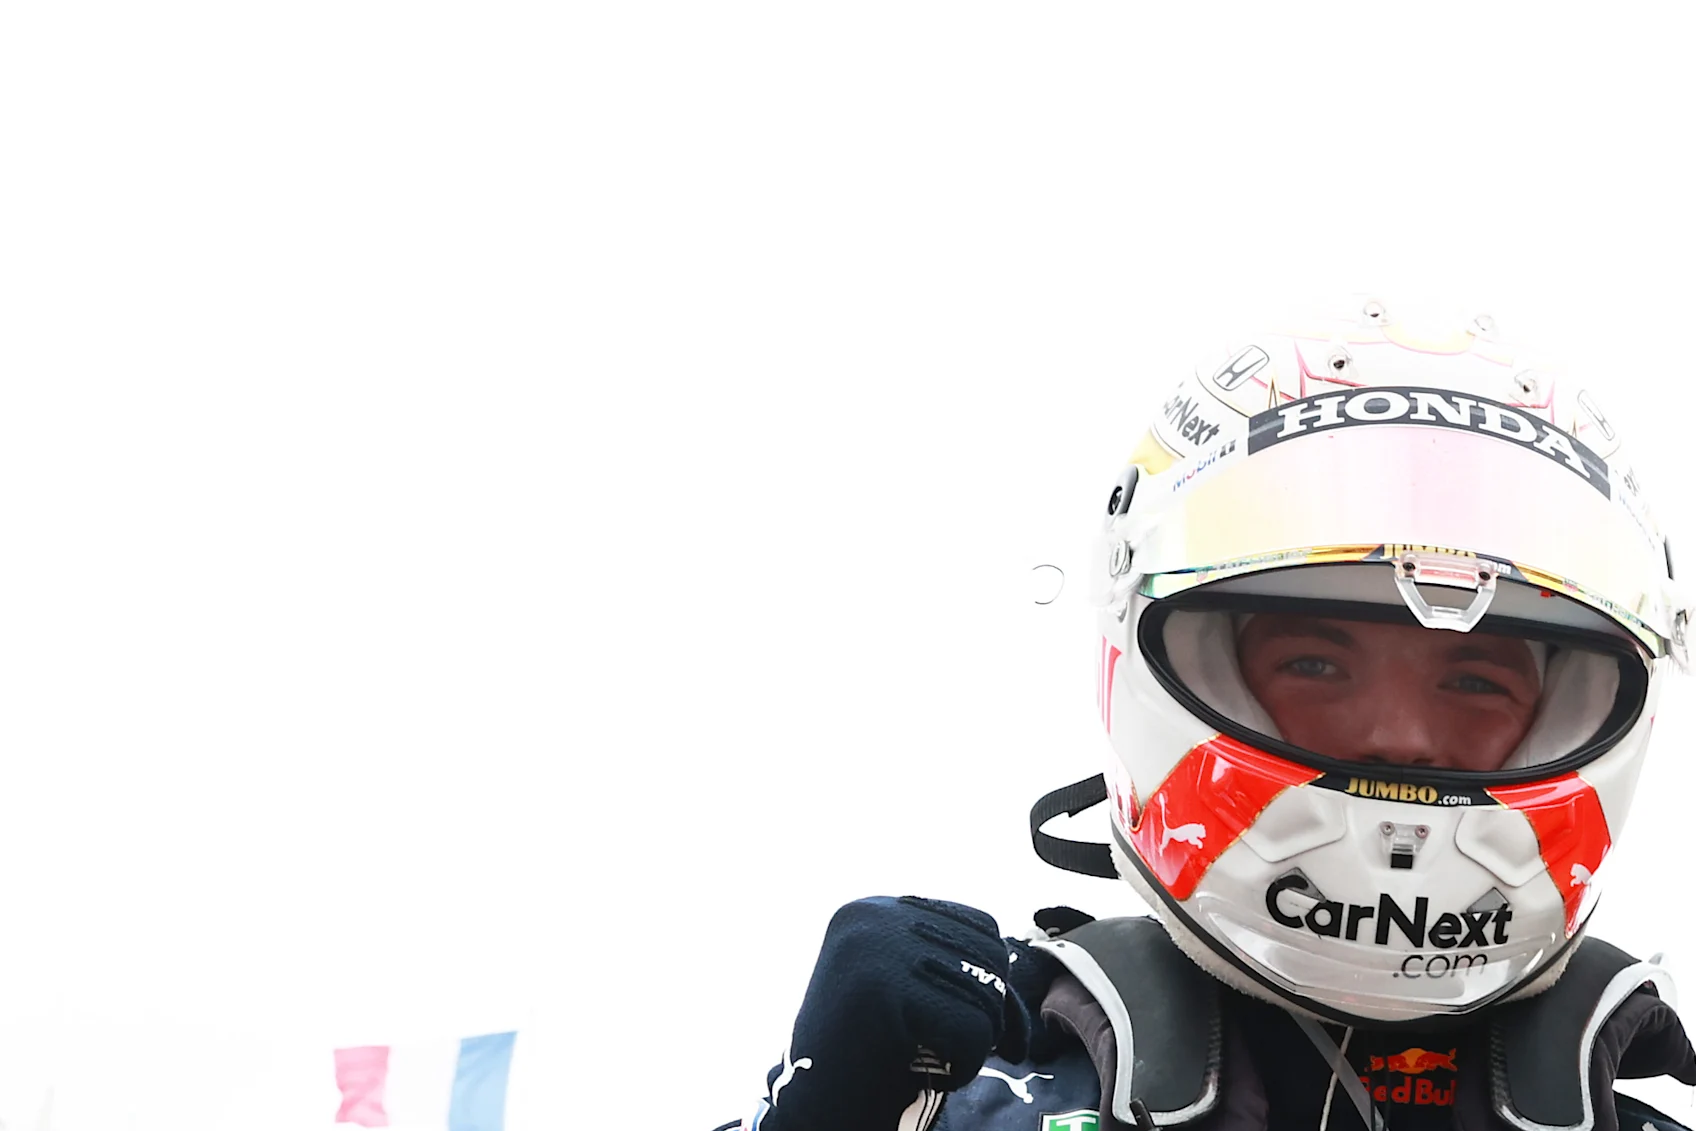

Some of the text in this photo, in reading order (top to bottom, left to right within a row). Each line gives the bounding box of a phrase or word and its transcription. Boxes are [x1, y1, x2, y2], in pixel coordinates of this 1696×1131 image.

[1276, 390, 1591, 479] HONDA
[1265, 874, 1513, 949] CarNext
[1414, 1078, 1457, 1106] Bul
